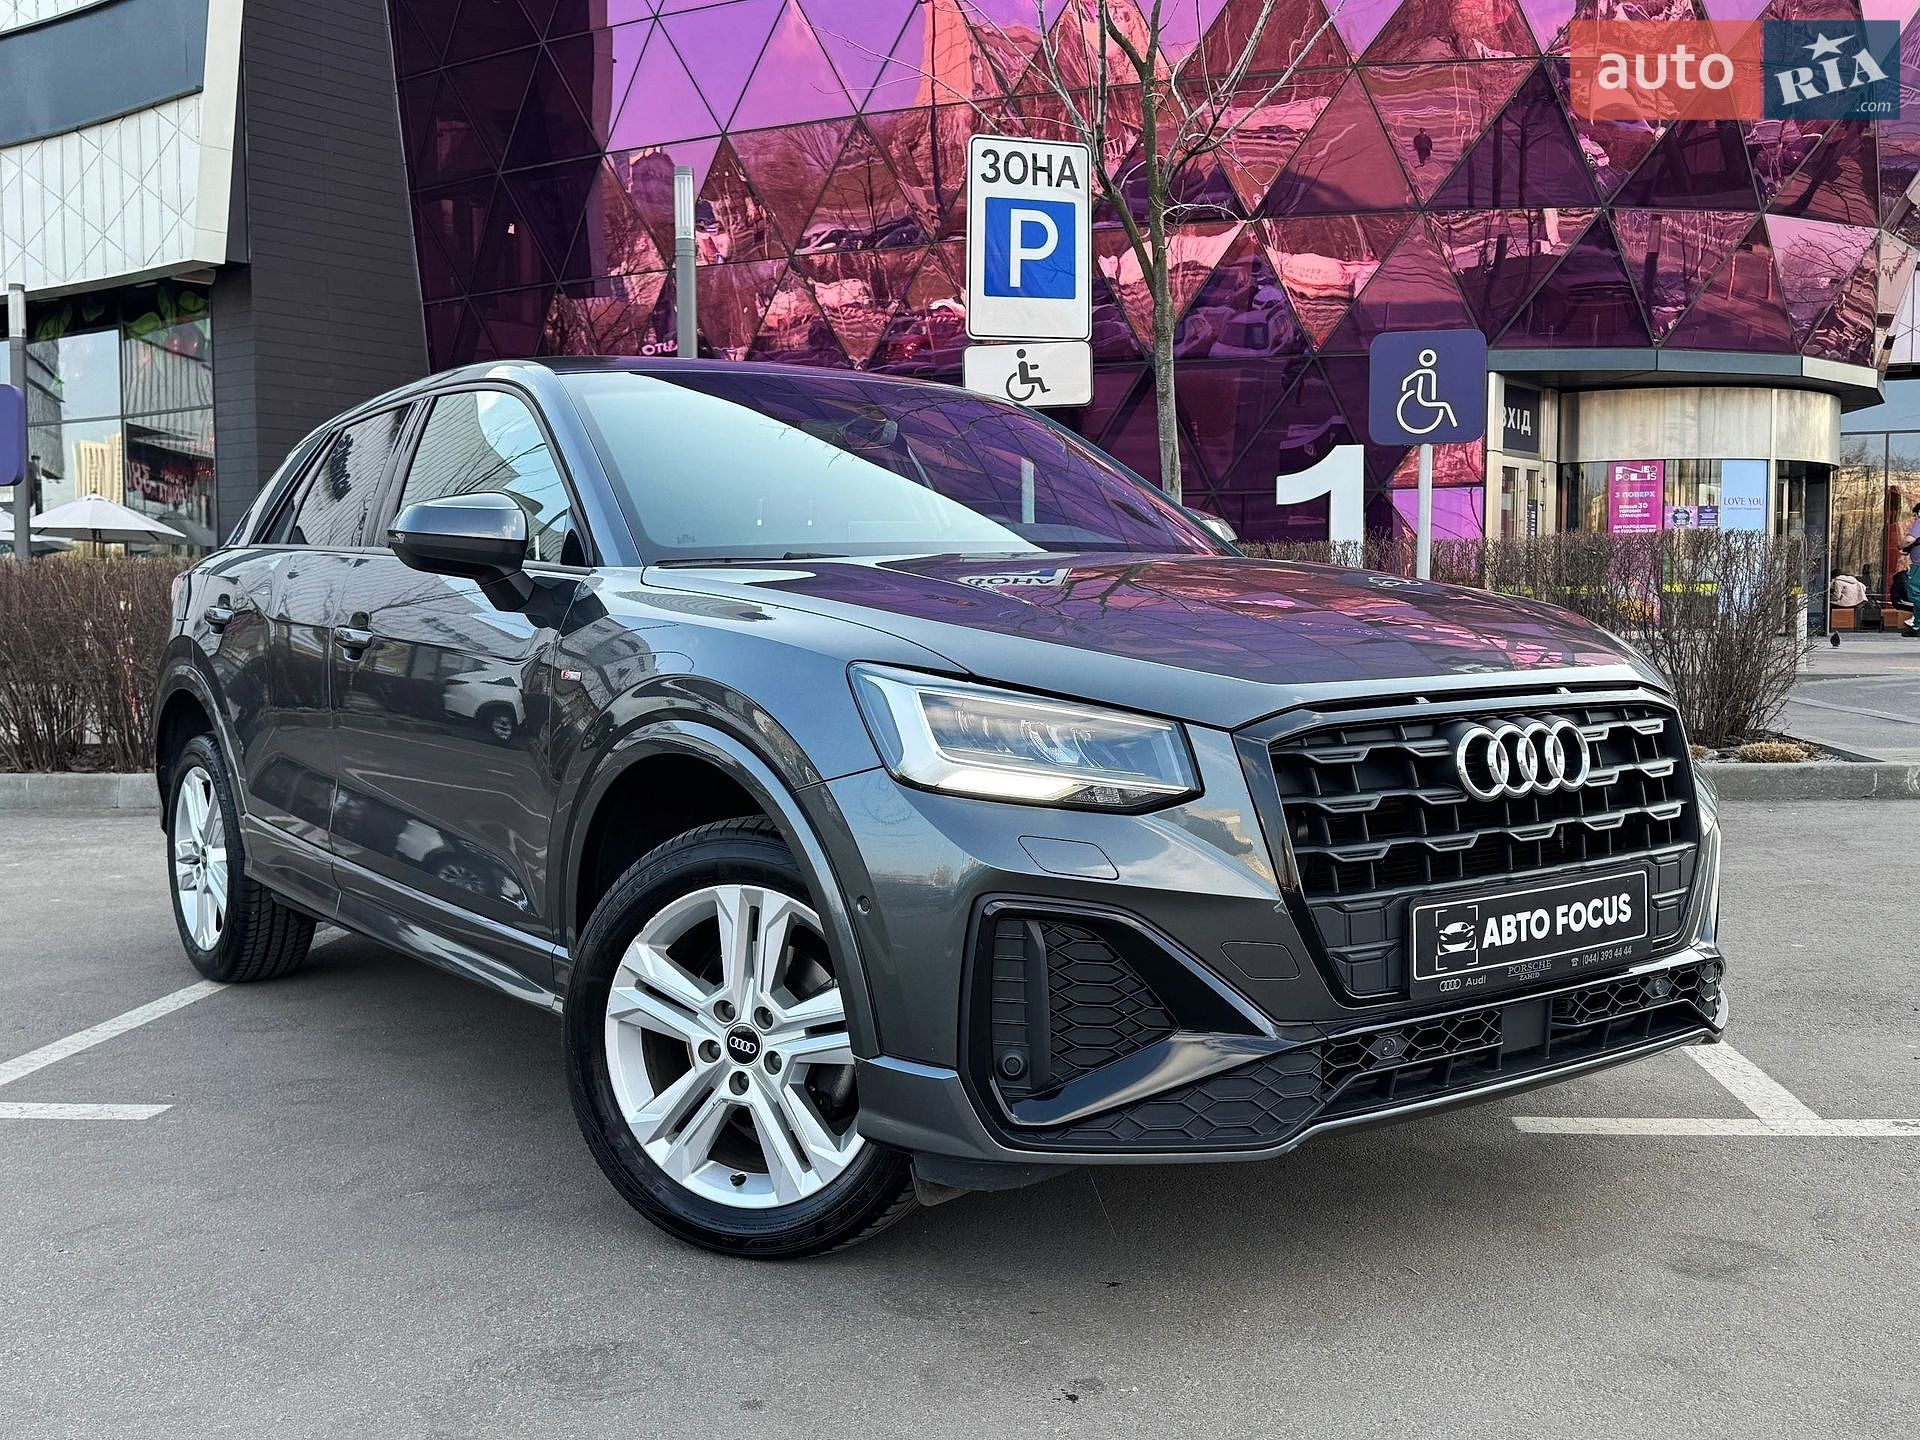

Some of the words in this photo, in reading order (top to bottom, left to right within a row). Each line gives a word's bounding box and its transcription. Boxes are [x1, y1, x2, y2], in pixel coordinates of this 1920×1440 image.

[980, 148, 1080, 190] ЗОНА
[1009, 208, 1059, 288] P
[1276, 444, 1365, 568] 1
[1723, 496, 1746, 505] LOVE
[1748, 496, 1765, 505] YOU
[1482, 908, 1551, 949] АВТО
[1556, 893, 1632, 936] FOCUS
[1508, 960, 1553, 975] PORSCHE
[1582, 951, 1600, 966] (044)
[1600, 949, 1613, 961] 393
[1465, 974, 1487, 987] Audi
